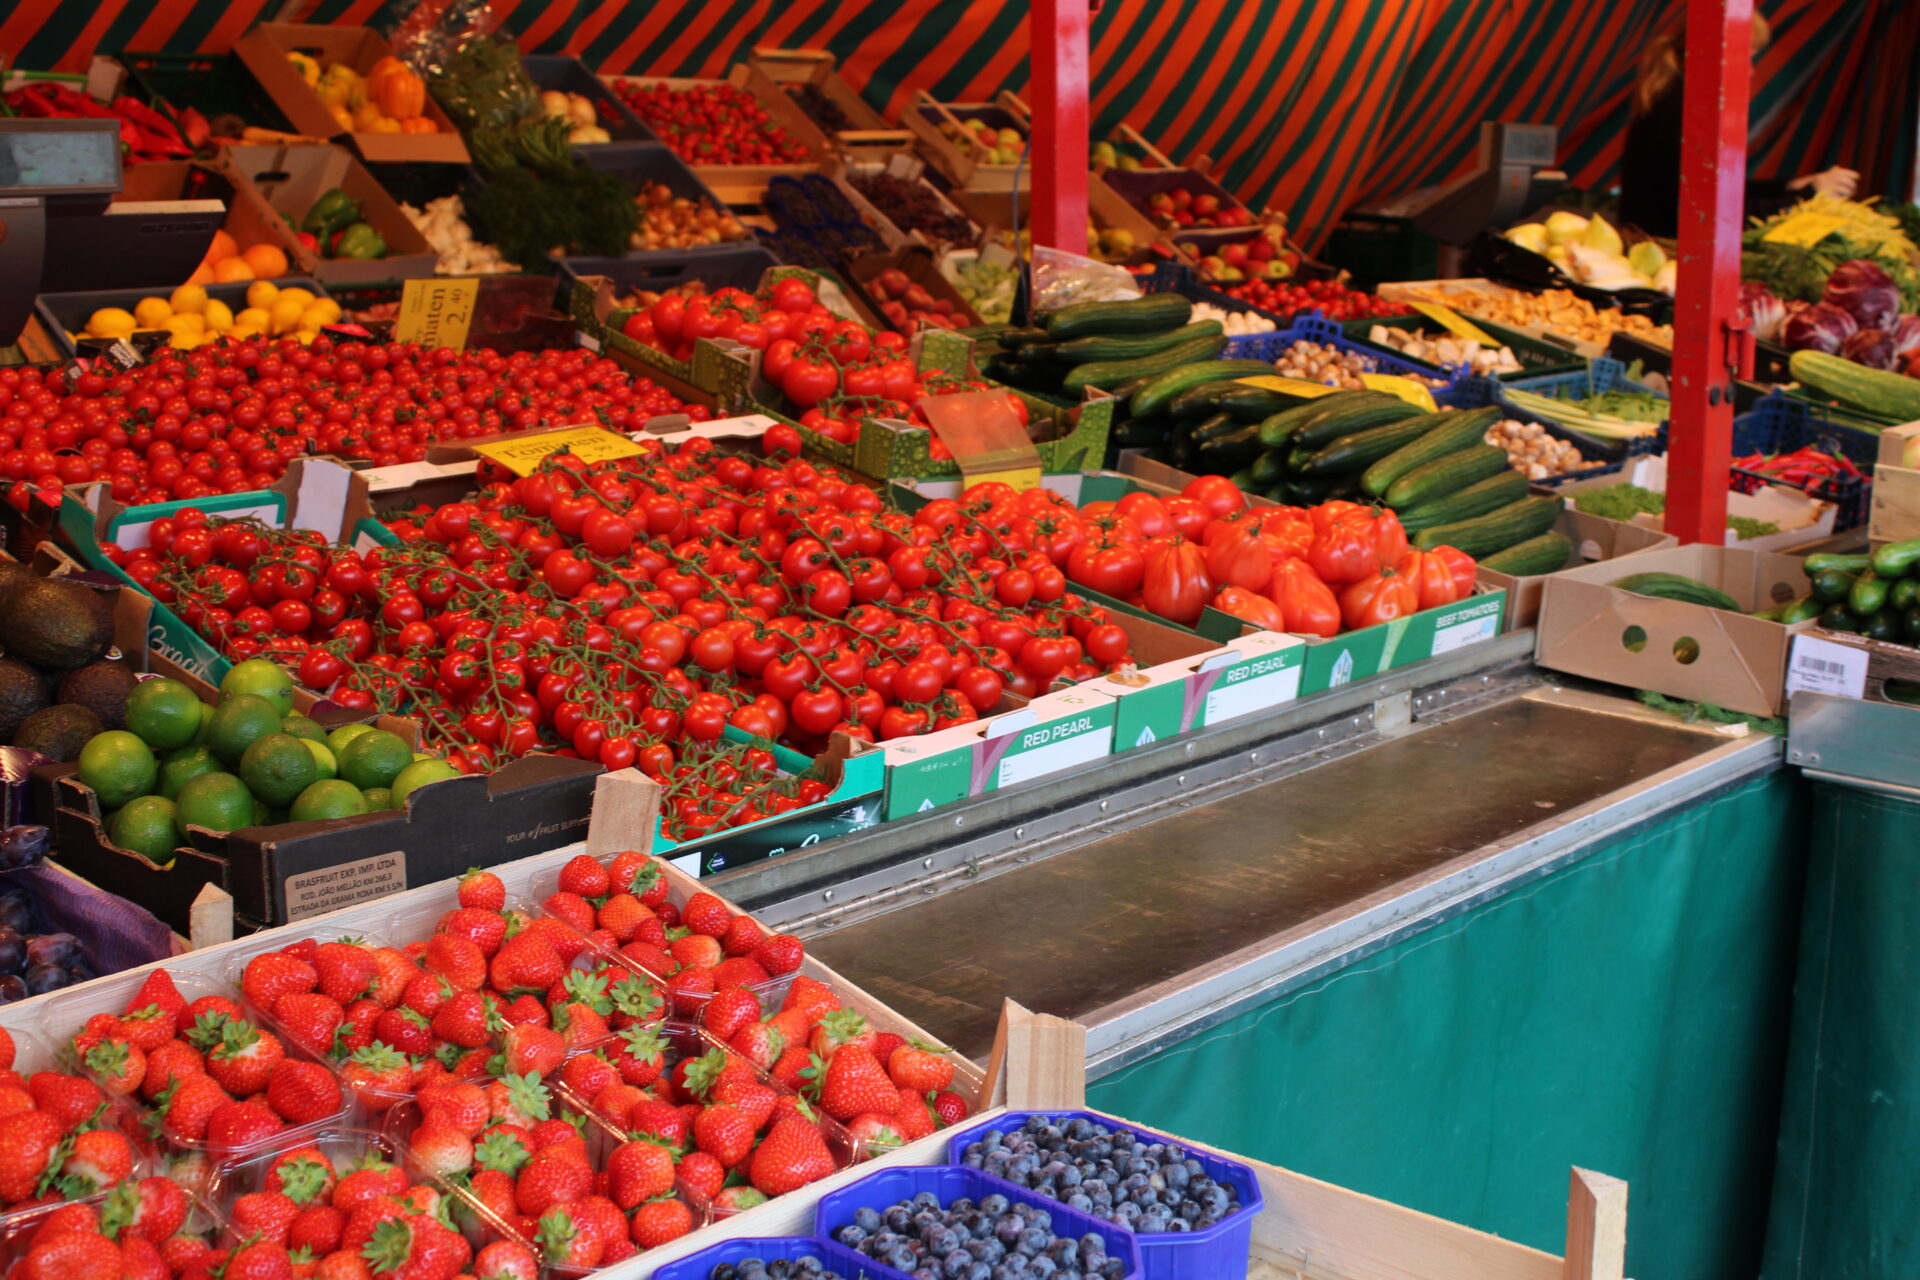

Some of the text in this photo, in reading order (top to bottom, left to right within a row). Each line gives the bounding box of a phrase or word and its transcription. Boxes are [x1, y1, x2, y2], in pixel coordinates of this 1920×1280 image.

[1435, 600, 1501, 629] BEEF TOMATOES
[1226, 655, 1286, 684] RED PEARL
[1023, 716, 1094, 749] RED PEARL
[505, 831, 526, 844] YOUR
[540, 822, 560, 836] FRUIT
[294, 859, 397, 890] BRASFRUIT EXP. IMP. LTDA
[318, 886, 336, 898] JOÃO
[363, 877, 375, 886] KM
[290, 903, 319, 916] ESTRADA
[320, 900, 330, 909] DA
[331, 893, 356, 906] GRAMA
[374, 886, 387, 895] KM
